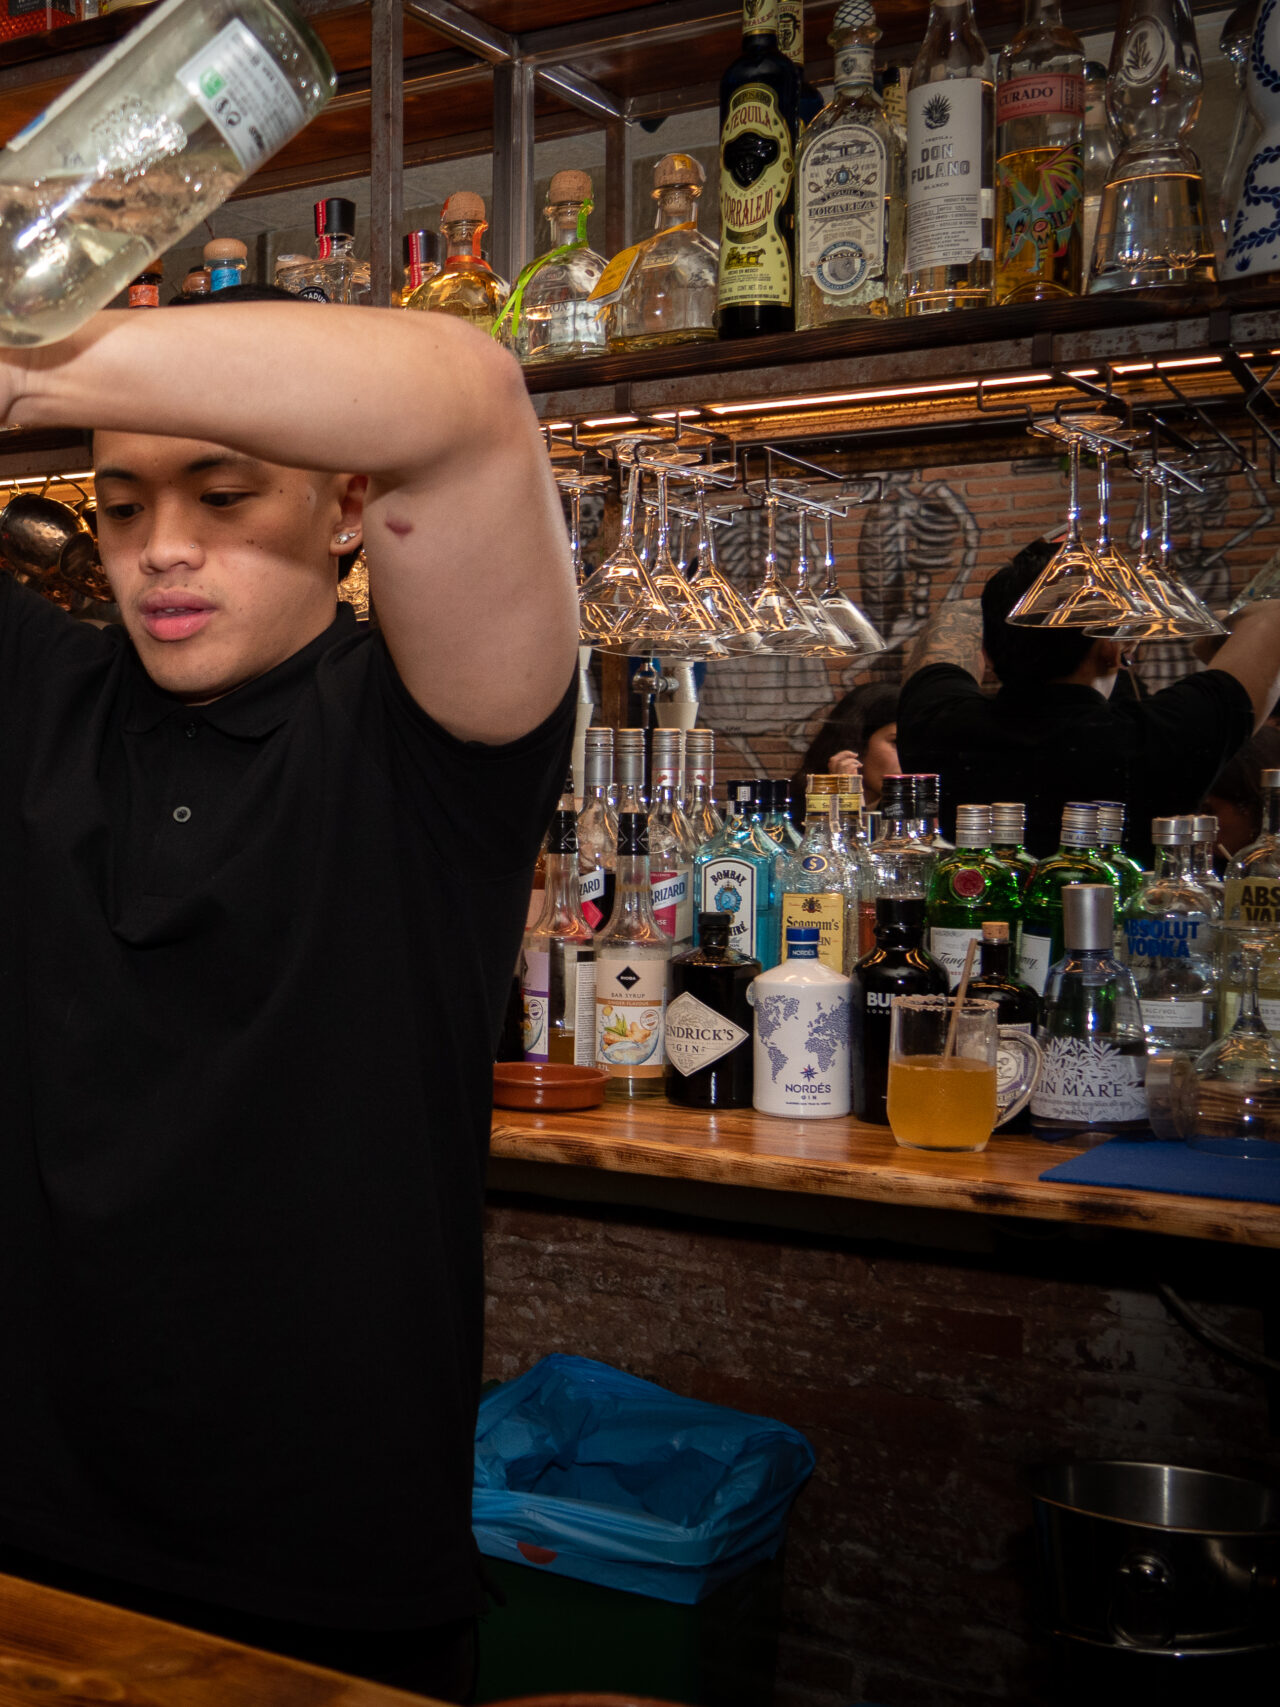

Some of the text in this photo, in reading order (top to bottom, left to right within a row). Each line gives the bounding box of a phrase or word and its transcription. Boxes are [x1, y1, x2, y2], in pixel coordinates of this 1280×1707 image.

[730, 106, 772, 134] TEQUILA
[921, 143, 953, 163] DON
[911, 160, 970, 185] FULANO
[808, 200, 875, 217] FORTALEZA
[579, 878, 601, 897] ZARD
[710, 870, 747, 886] BOMBAY
[1124, 919, 1200, 939] ABSOLUT
[1128, 938, 1191, 958] VODKA
[676, 1044, 699, 1053] GIN
[785, 1083, 832, 1094] NORDÉS
[1063, 1082, 1123, 1097] MARE
